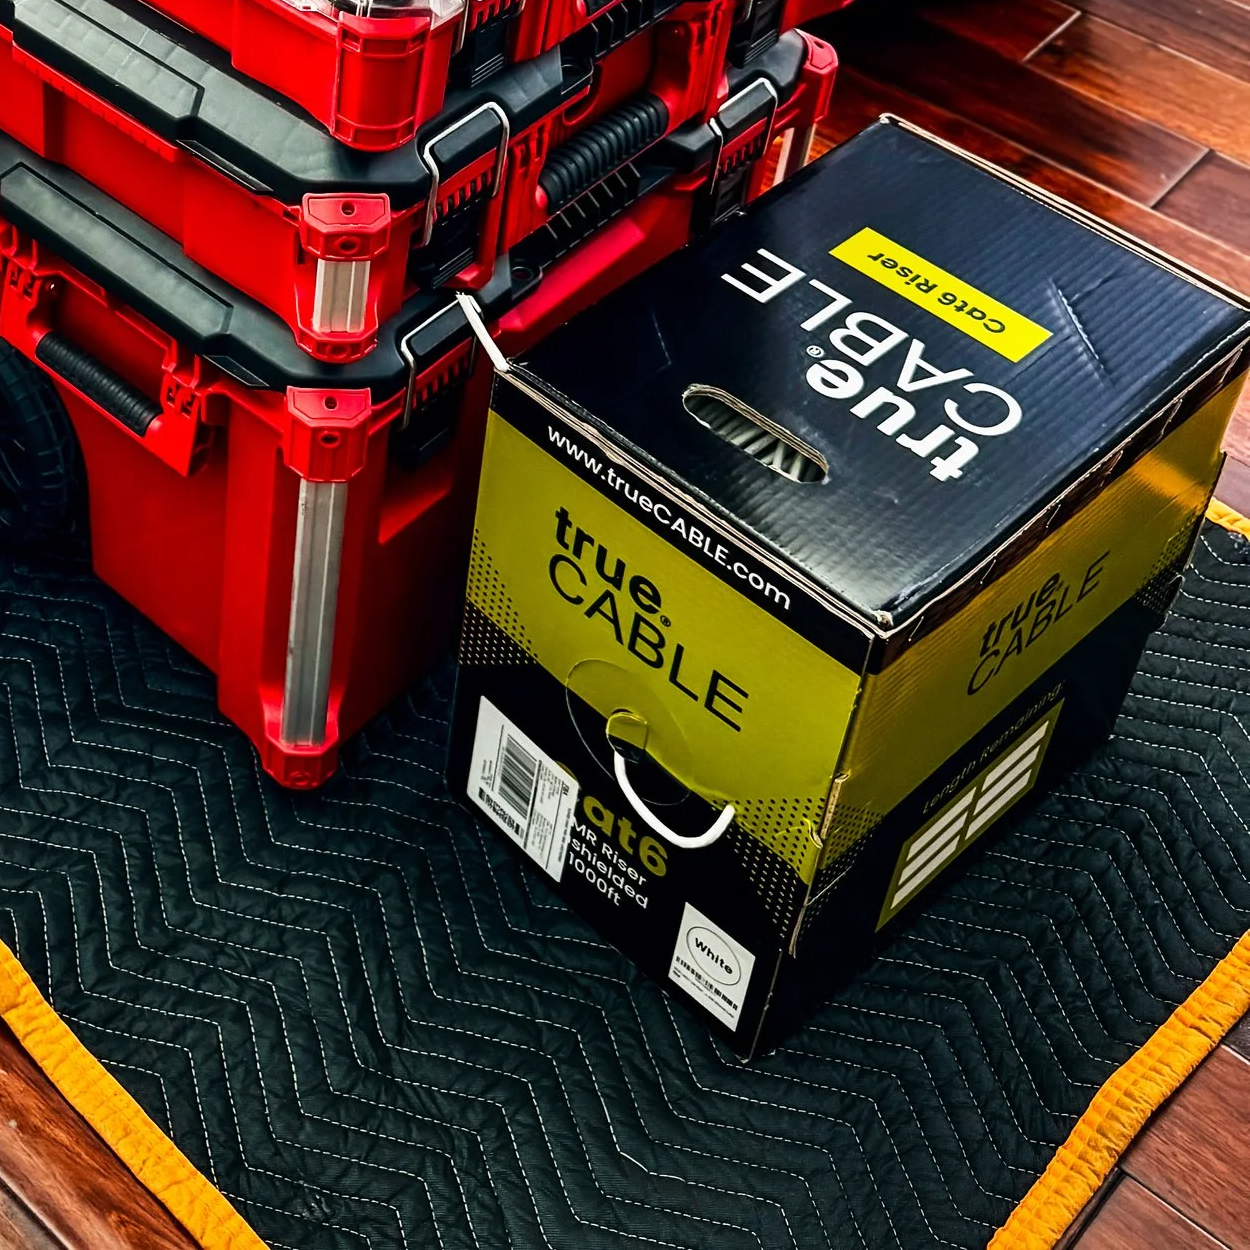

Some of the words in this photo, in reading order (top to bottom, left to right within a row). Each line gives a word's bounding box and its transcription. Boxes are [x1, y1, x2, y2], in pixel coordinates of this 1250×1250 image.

[867, 252, 938, 294] Riser
[720, 248, 1023, 437] CABLE
[937, 292, 1006, 334] Cat6
[547, 425, 792, 611] www.trueCABLE.com
[549, 554, 749, 733] CABLE
[967, 550, 1111, 696] CABLE
[922, 759, 976, 815] Length
[565, 775, 668, 877] at6
[572, 816, 598, 847] MR
[601, 842, 647, 886] Riser
[569, 836, 649, 909] shielded
[569, 851, 622, 907] 1000ft
[695, 936, 733, 975] White
